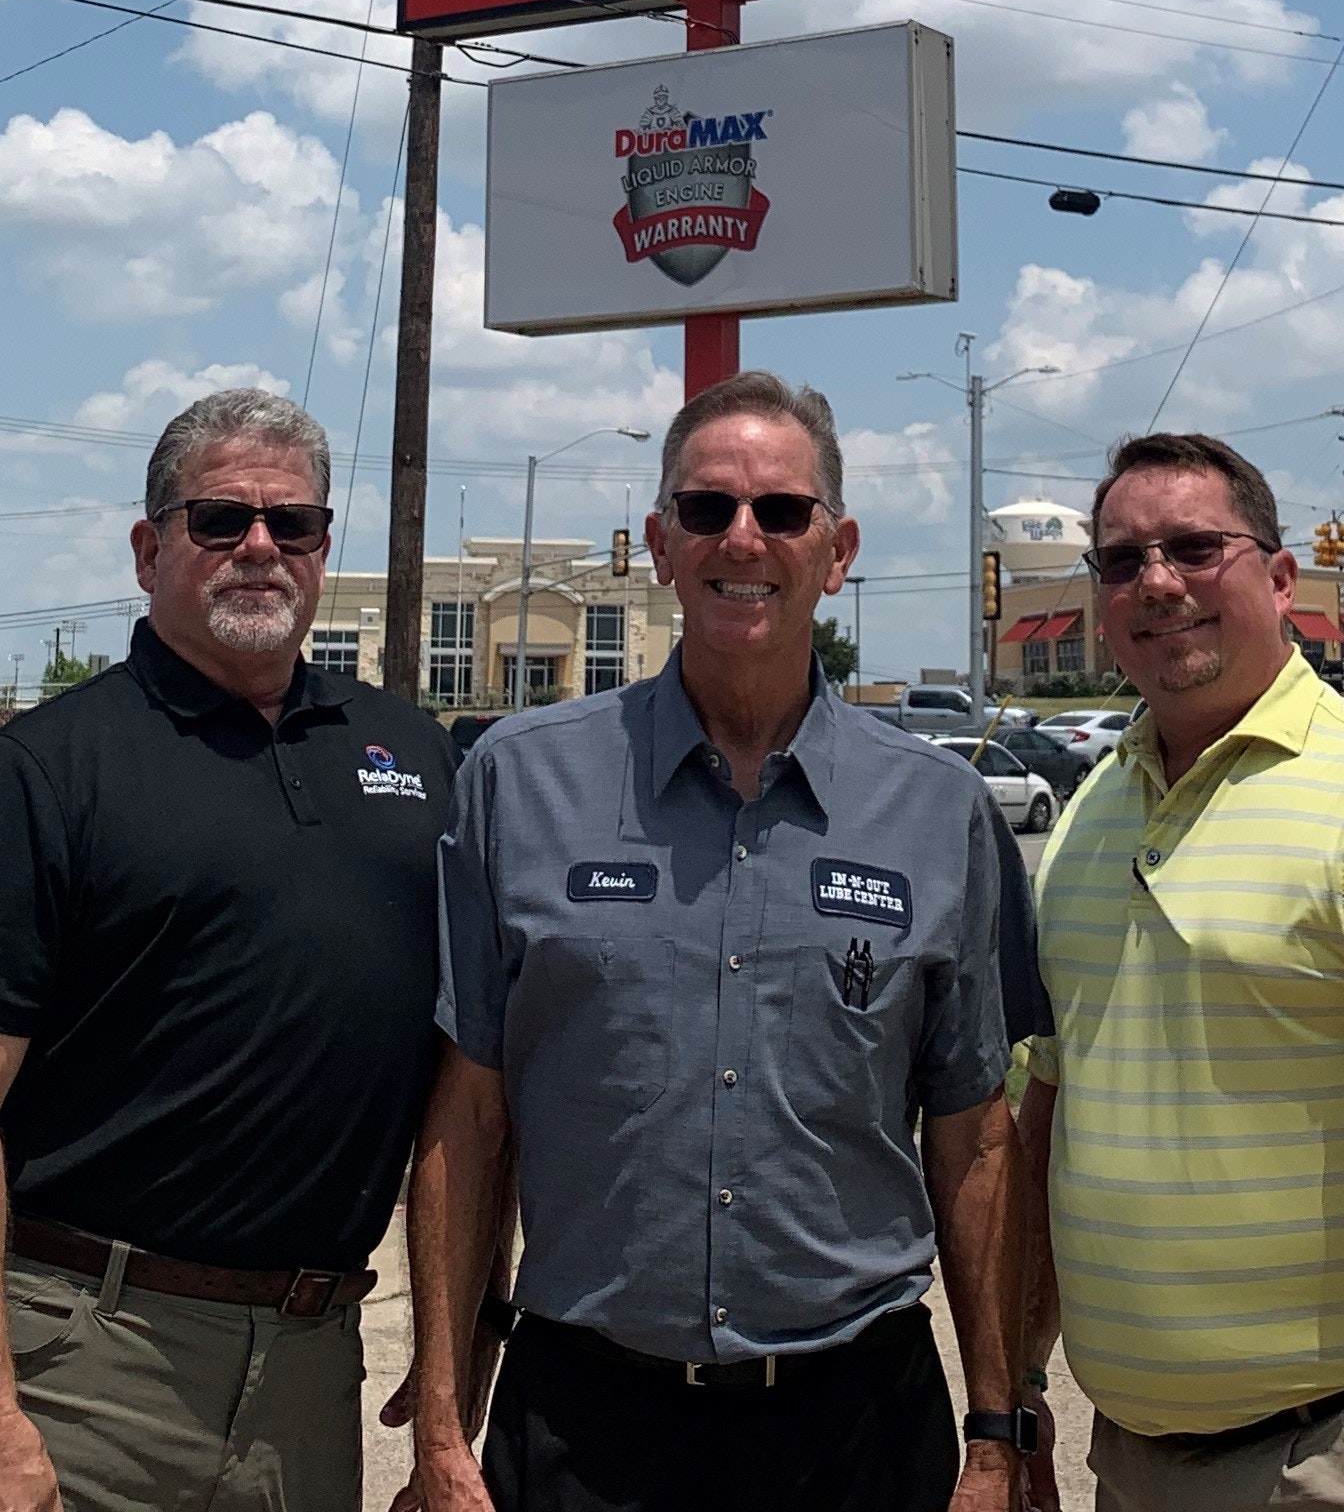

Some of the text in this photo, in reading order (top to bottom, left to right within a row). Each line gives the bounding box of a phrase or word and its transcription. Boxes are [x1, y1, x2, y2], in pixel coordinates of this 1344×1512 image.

[622, 152, 757, 193] LIQUID ARMOR
[654, 182, 725, 207] ENGINE
[633, 214, 749, 254] WARRANTY
[357, 769, 422, 788] RelaDyne
[399, 786, 427, 800] Services
[587, 871, 636, 888] Kevin
[819, 885, 904, 912] LUBE CENTER
